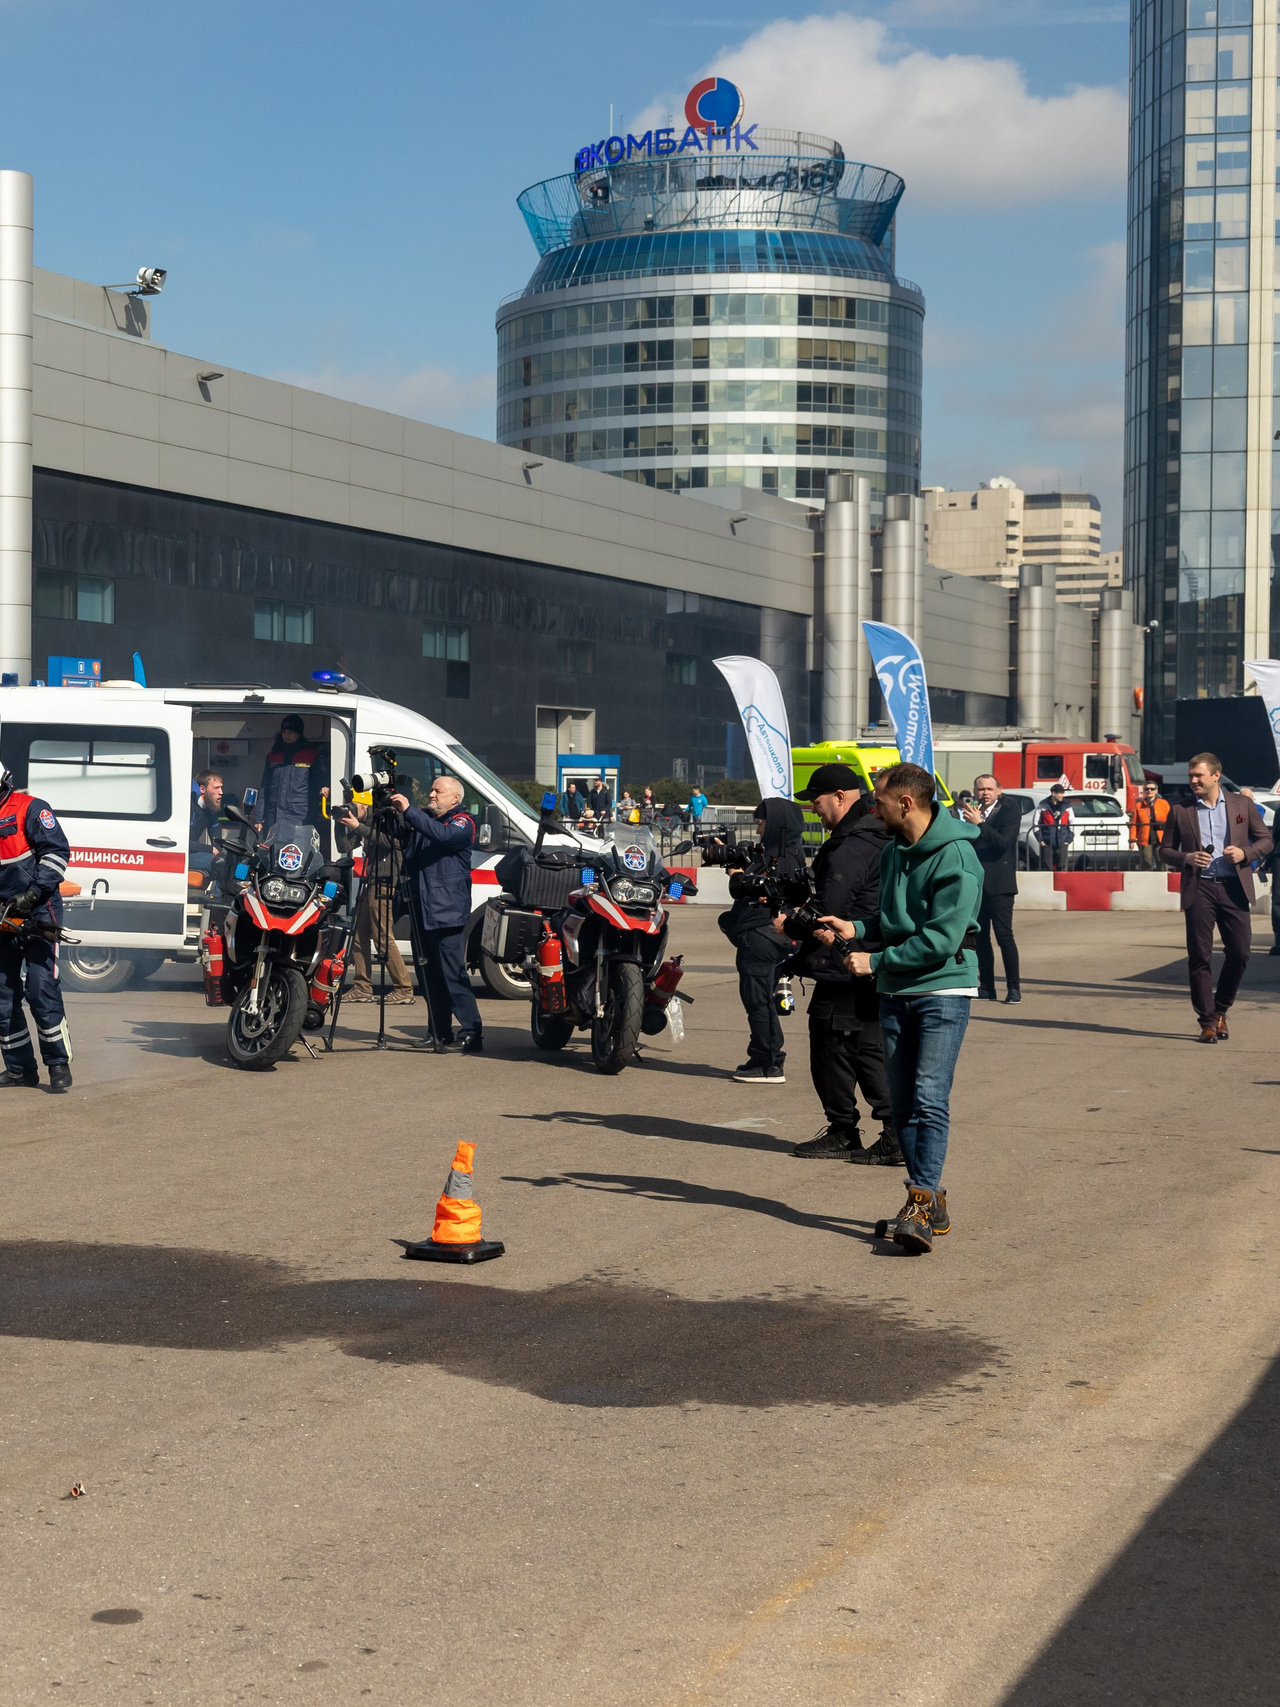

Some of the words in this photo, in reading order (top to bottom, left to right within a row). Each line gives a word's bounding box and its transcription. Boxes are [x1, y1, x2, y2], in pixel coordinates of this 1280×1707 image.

[574, 124, 759, 179] ВКОМБАНК
[1084, 780, 1108, 790] 402
[69, 851, 144, 865] ДИЦИНСКАЯ
